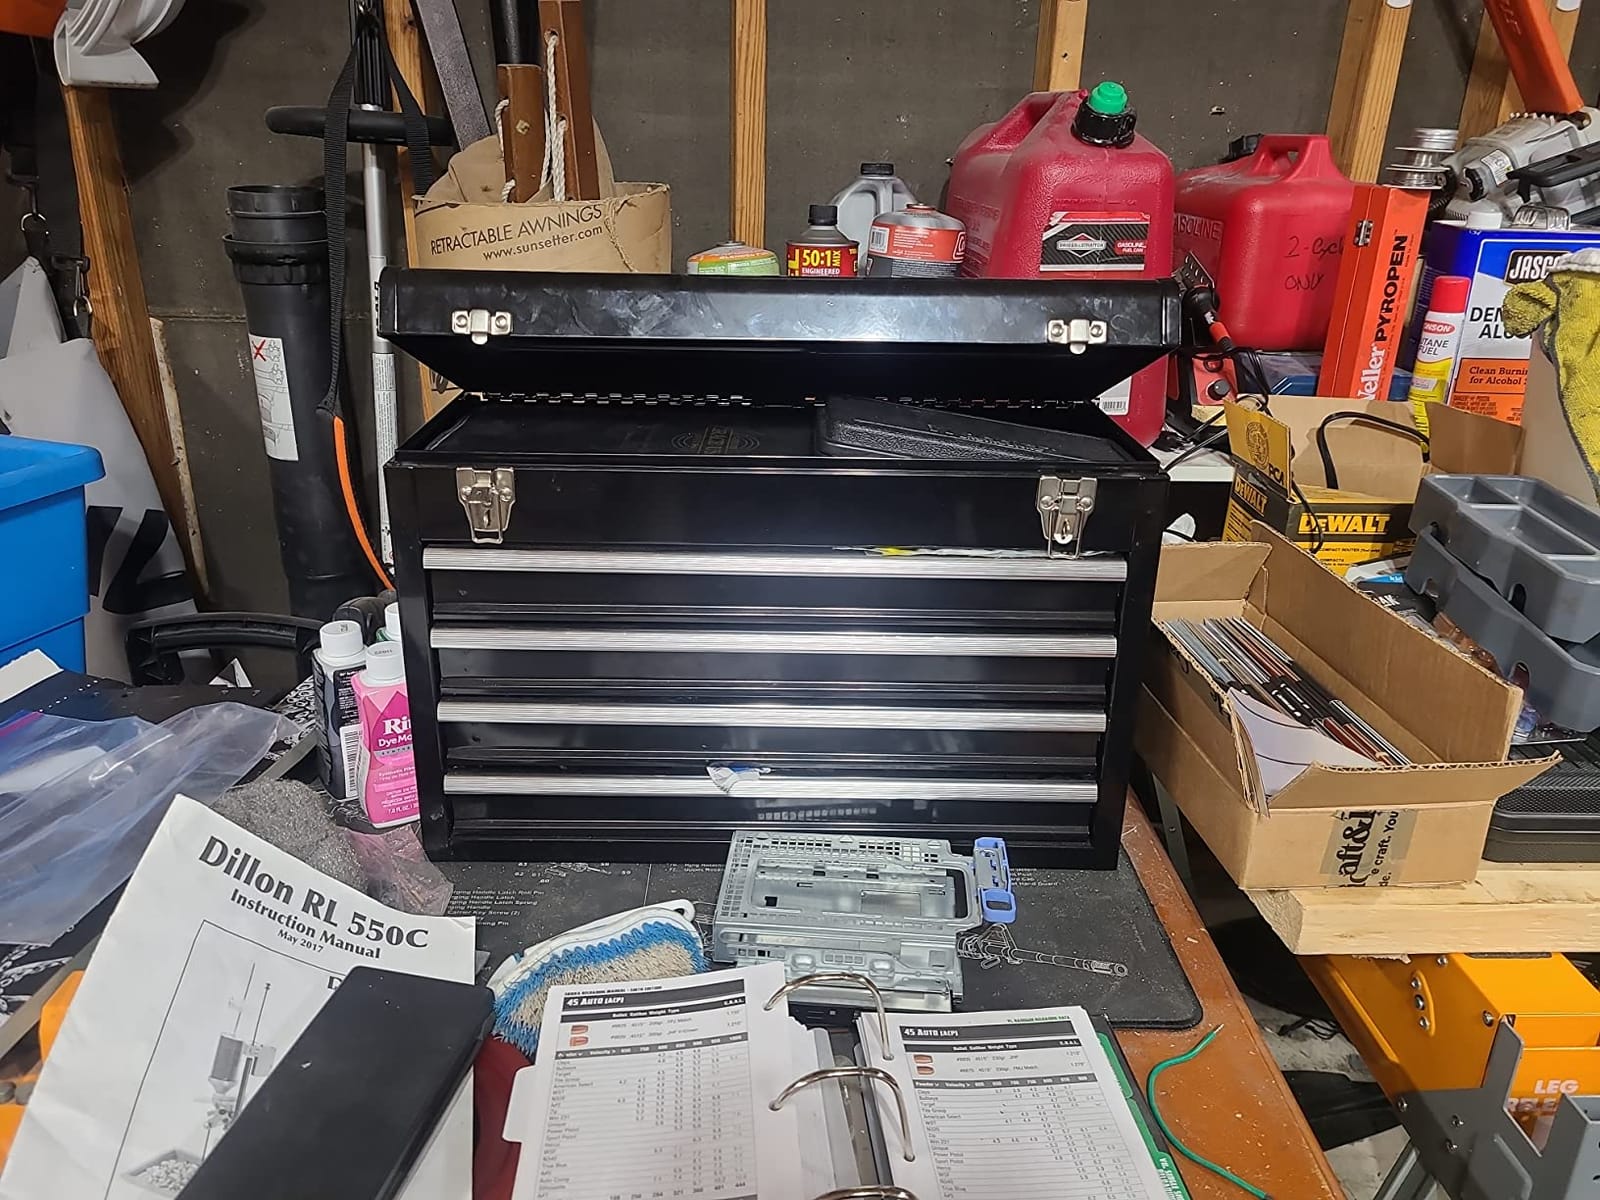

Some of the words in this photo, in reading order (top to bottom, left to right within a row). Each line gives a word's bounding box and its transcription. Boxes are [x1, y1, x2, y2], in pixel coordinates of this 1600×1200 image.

[431, 224, 512, 255] RETRACTABLE
[517, 204, 602, 238] AWNINGS
[483, 225, 602, 260] www.sunsetter.com
[802, 249, 831, 267] 50:1
[1509, 255, 1560, 279] JASC
[1375, 235, 1409, 342] PYROPEN
[1421, 338, 1449, 348] TANE
[1469, 376, 1483, 384] for
[1485, 376, 1521, 384] Alcohol
[378, 734, 412, 747] DyeMo
[198, 836, 294, 904] Dillon
[301, 888, 339, 927] RL
[347, 912, 429, 948] 550C
[230, 889, 316, 938] Instruction
[319, 929, 381, 958] Manual
[277, 929, 297, 946] May
[300, 939, 324, 953] 2017
[567, 998, 578, 1006] 45
[904, 1028, 915, 1036] 45
[1534, 1080, 1579, 1094] LEG
